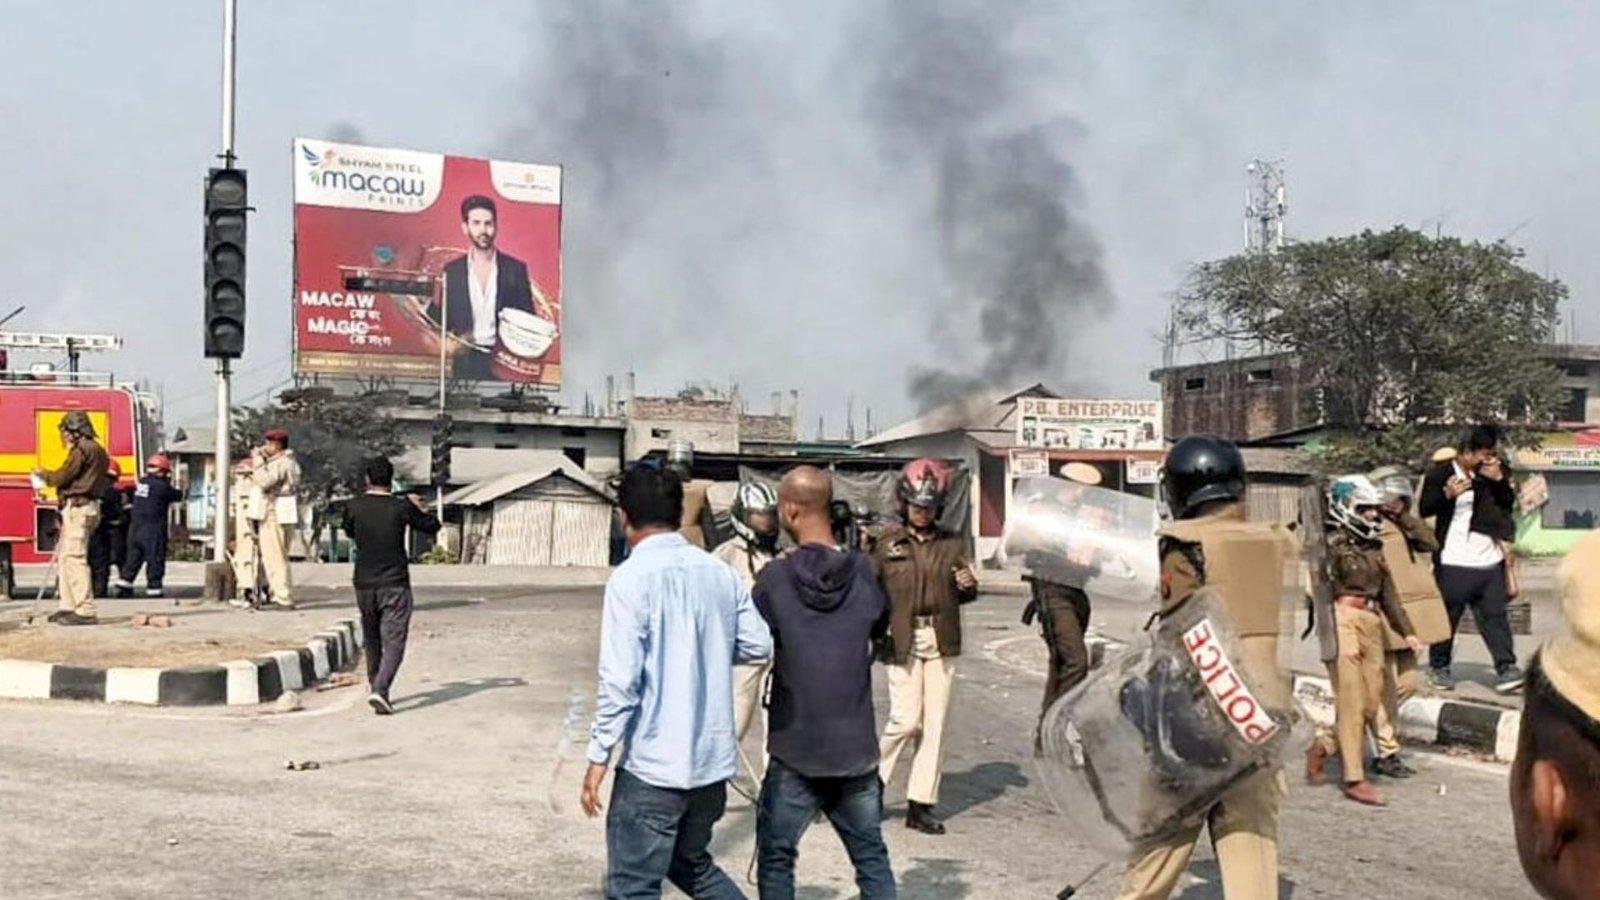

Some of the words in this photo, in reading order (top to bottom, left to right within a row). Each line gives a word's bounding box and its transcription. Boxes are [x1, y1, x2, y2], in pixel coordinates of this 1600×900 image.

[338, 157, 382, 169] SHYAM
[385, 163, 424, 174] STEEL
[322, 170, 425, 197] macaw
[367, 193, 425, 207] PAINTS
[300, 290, 376, 308] MACAW
[307, 316, 370, 335] MAGIC
[1023, 402, 1051, 415] P.B.
[1057, 402, 1157, 417] ENTERPRISE
[1186, 622, 1276, 743] POLICE
